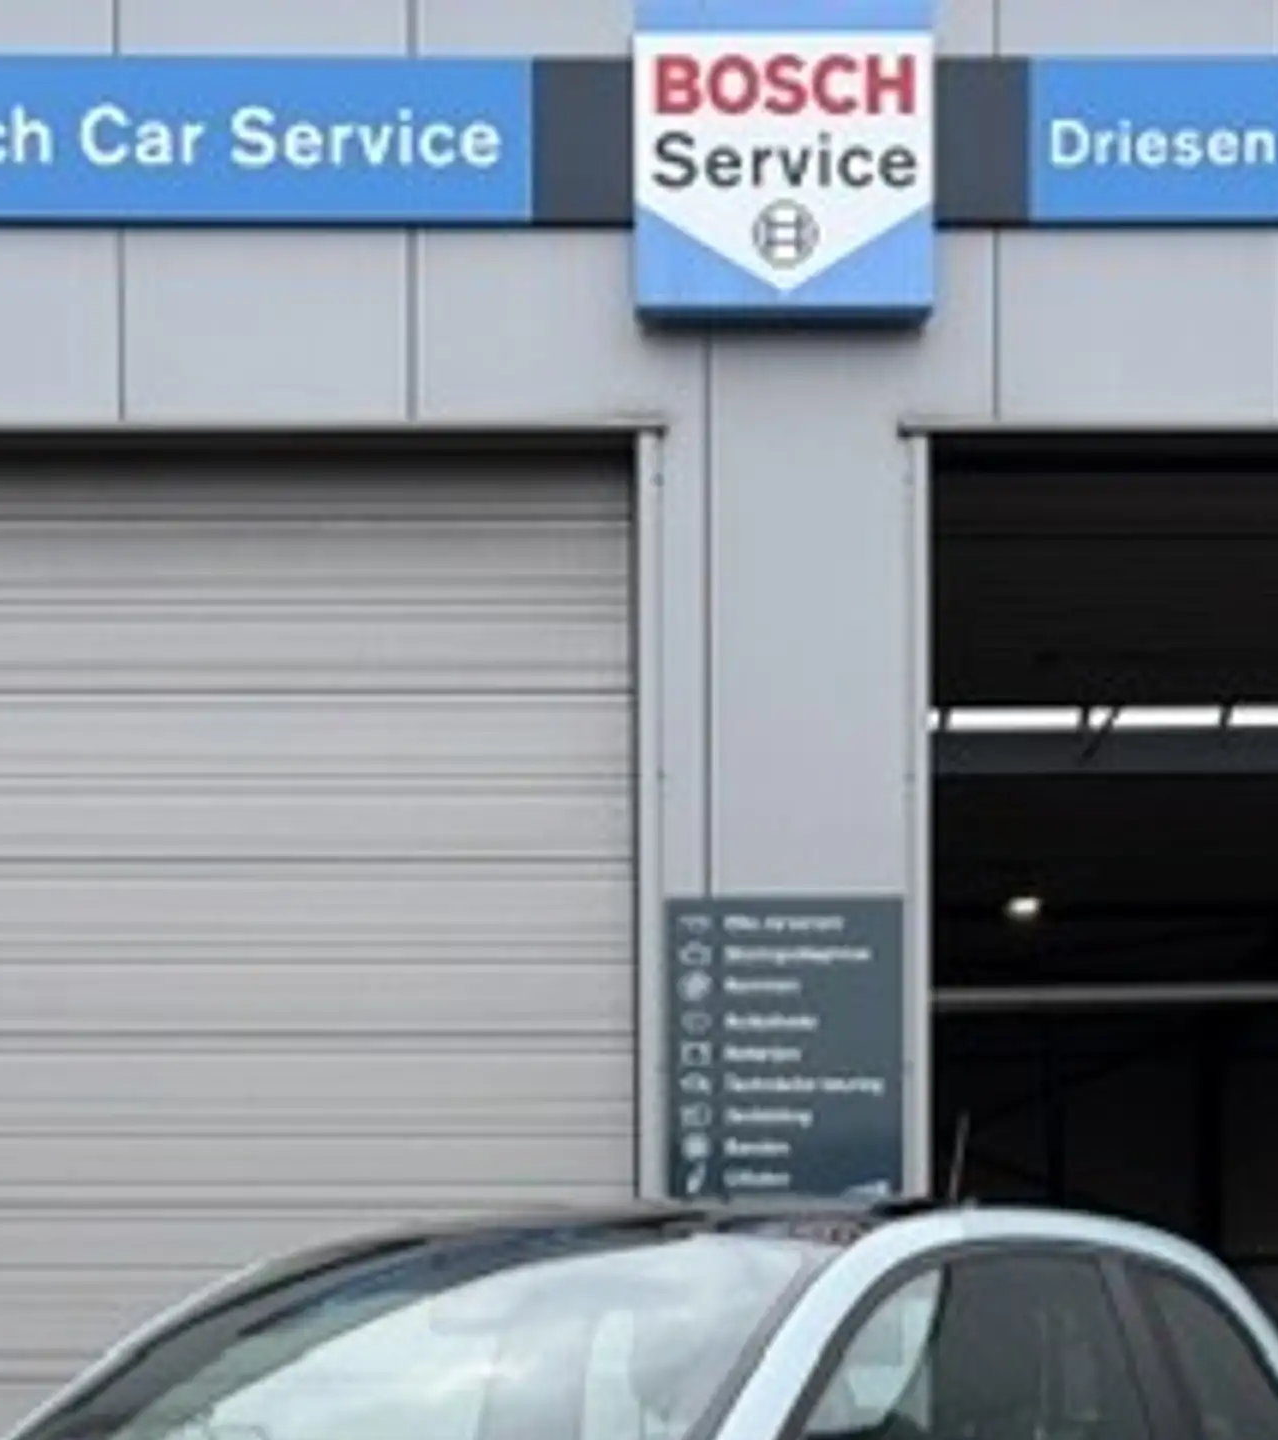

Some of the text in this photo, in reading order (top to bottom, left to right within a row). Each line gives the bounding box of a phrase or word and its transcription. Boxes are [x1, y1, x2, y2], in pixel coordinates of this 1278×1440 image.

[652, 52, 916, 117] BOSCH
[78, 102, 206, 166] Car
[229, 104, 502, 169] Service
[651, 129, 917, 189] Service
[1048, 117, 1276, 167] Driesen
